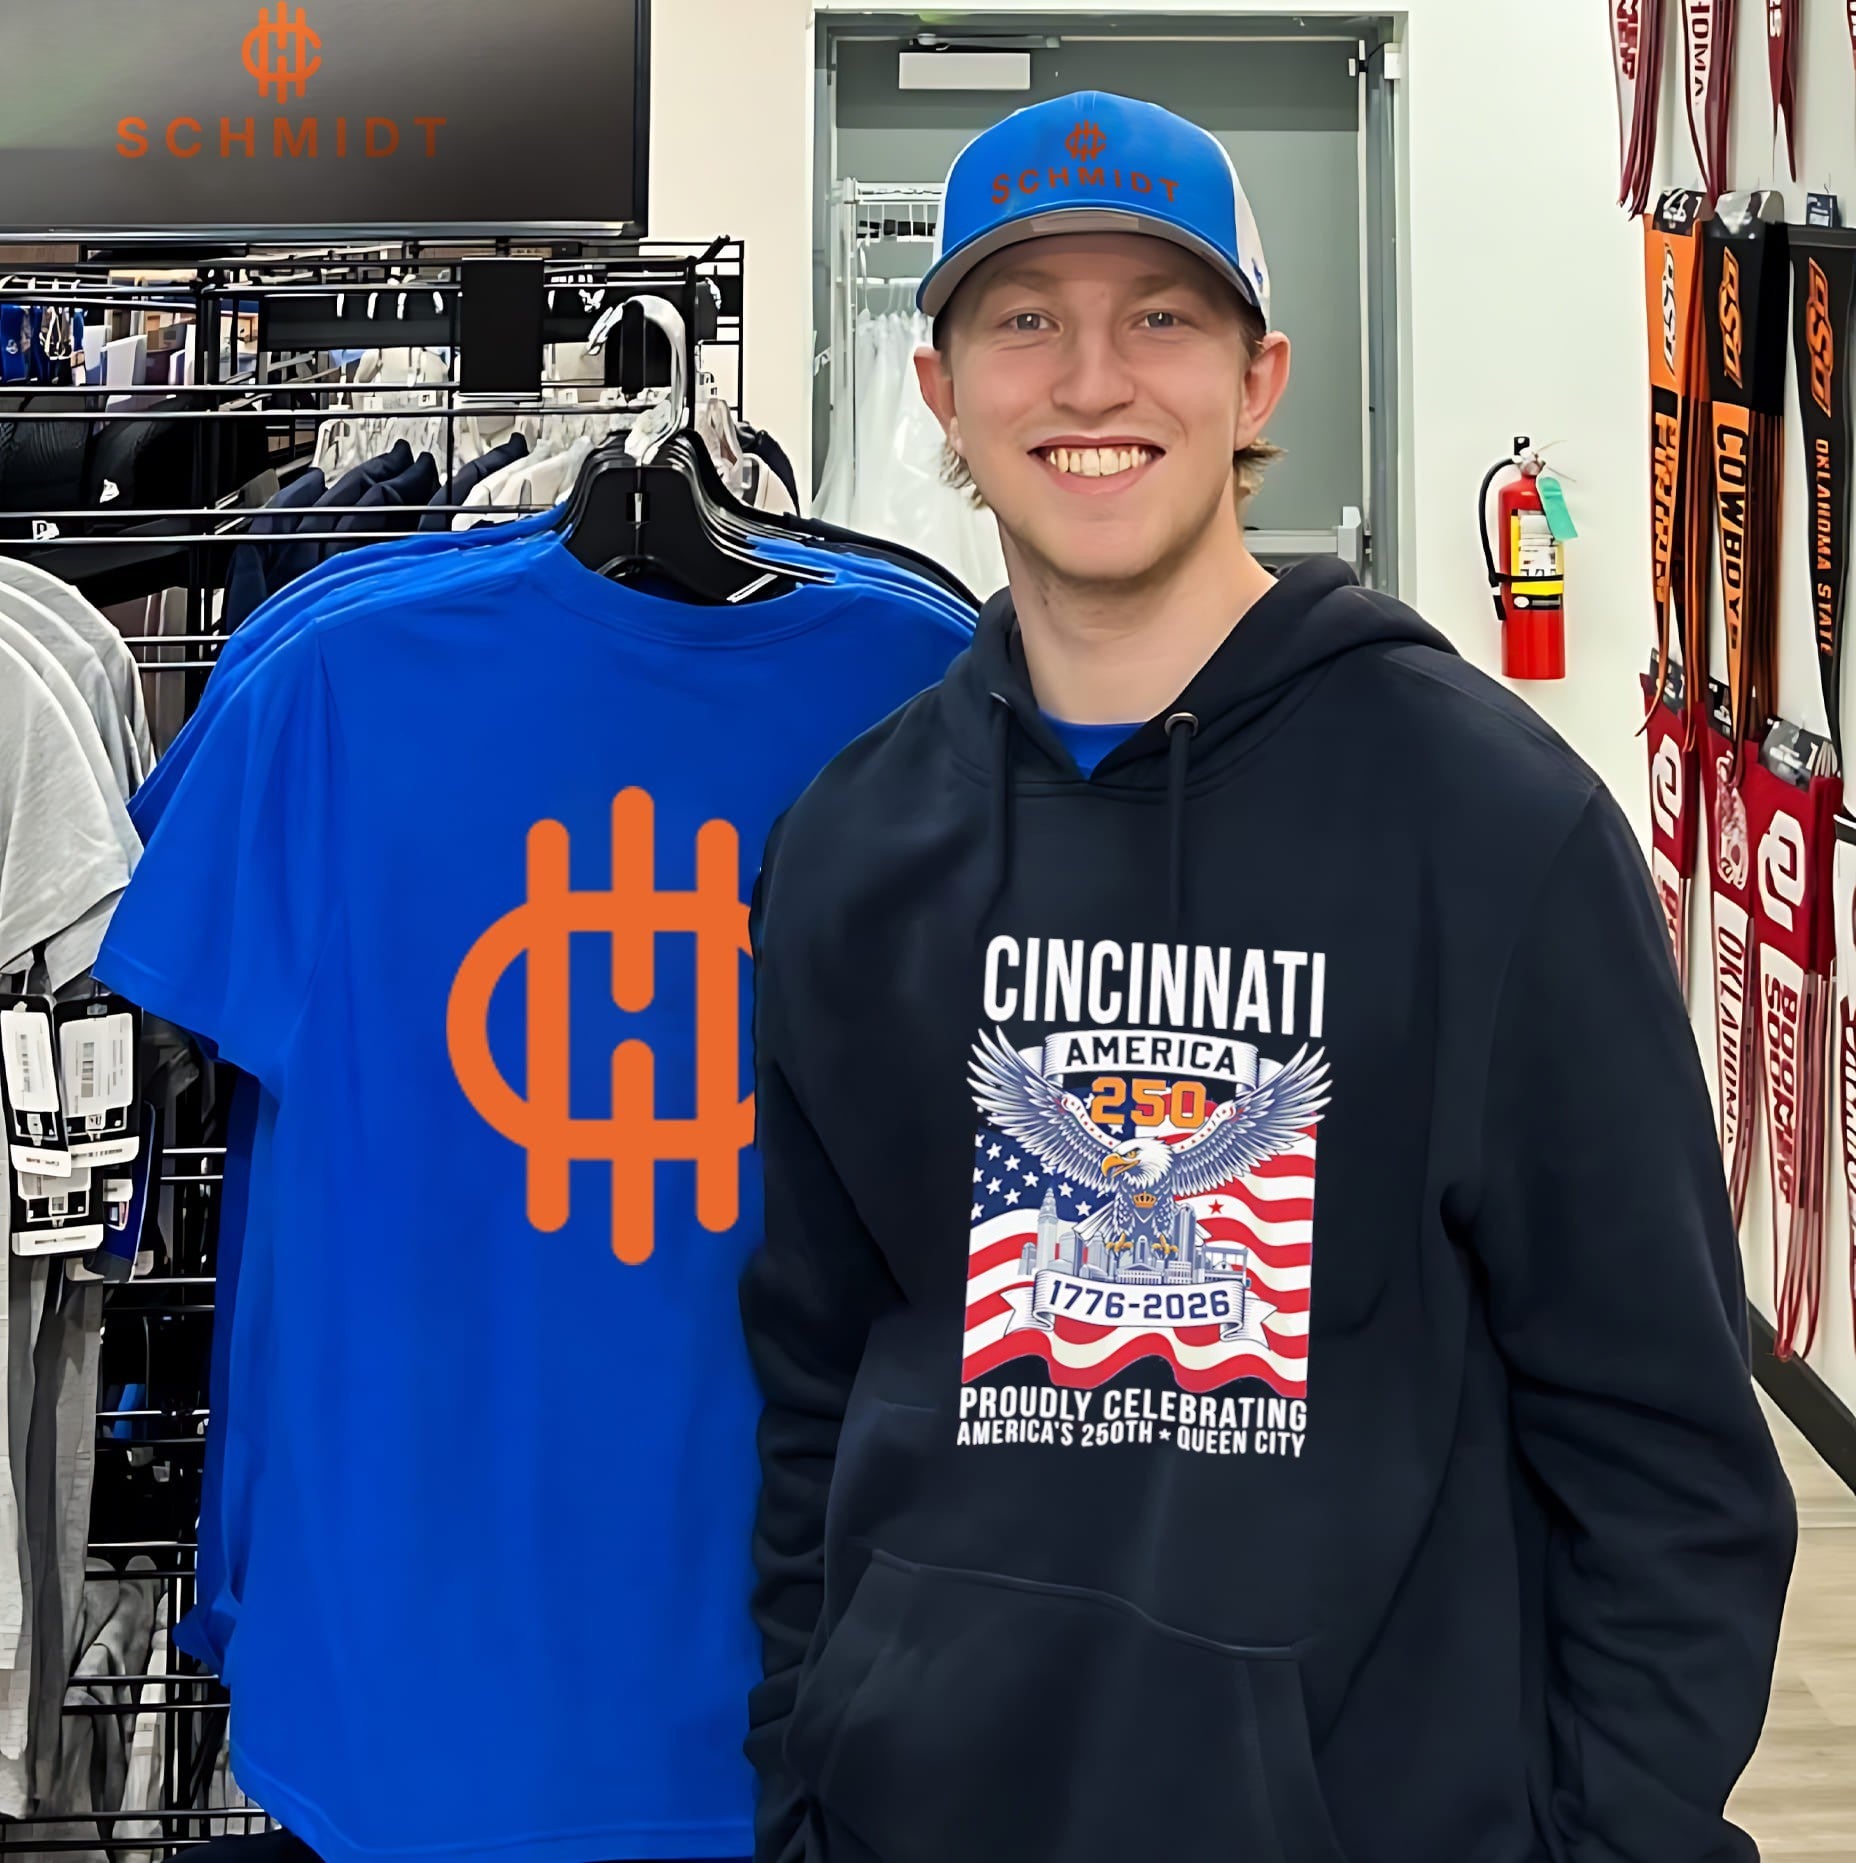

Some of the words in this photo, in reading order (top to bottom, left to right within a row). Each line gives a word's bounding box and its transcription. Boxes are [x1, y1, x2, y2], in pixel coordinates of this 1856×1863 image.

[116, 116, 447, 159] SCHMIDT
[991, 167, 1180, 204] SCHMIDT
[1815, 438, 1832, 570] OKLAHOMA
[1758, 809, 1806, 933] OU
[983, 934, 1327, 1038] CINCINNATI
[1065, 1036, 1237, 1075] AMERICA
[1090, 1076, 1207, 1128] 250
[1050, 1280, 1230, 1320] 1776-2026
[959, 1386, 1092, 1422] PROUDLY
[1103, 1388, 1308, 1431] CELEBRATING
[956, 1420, 1074, 1446] AMERICA'S
[1081, 1420, 1153, 1447] 250TH
[1176, 1426, 1247, 1454] QUEEN
[1254, 1430, 1306, 1458] CITY
